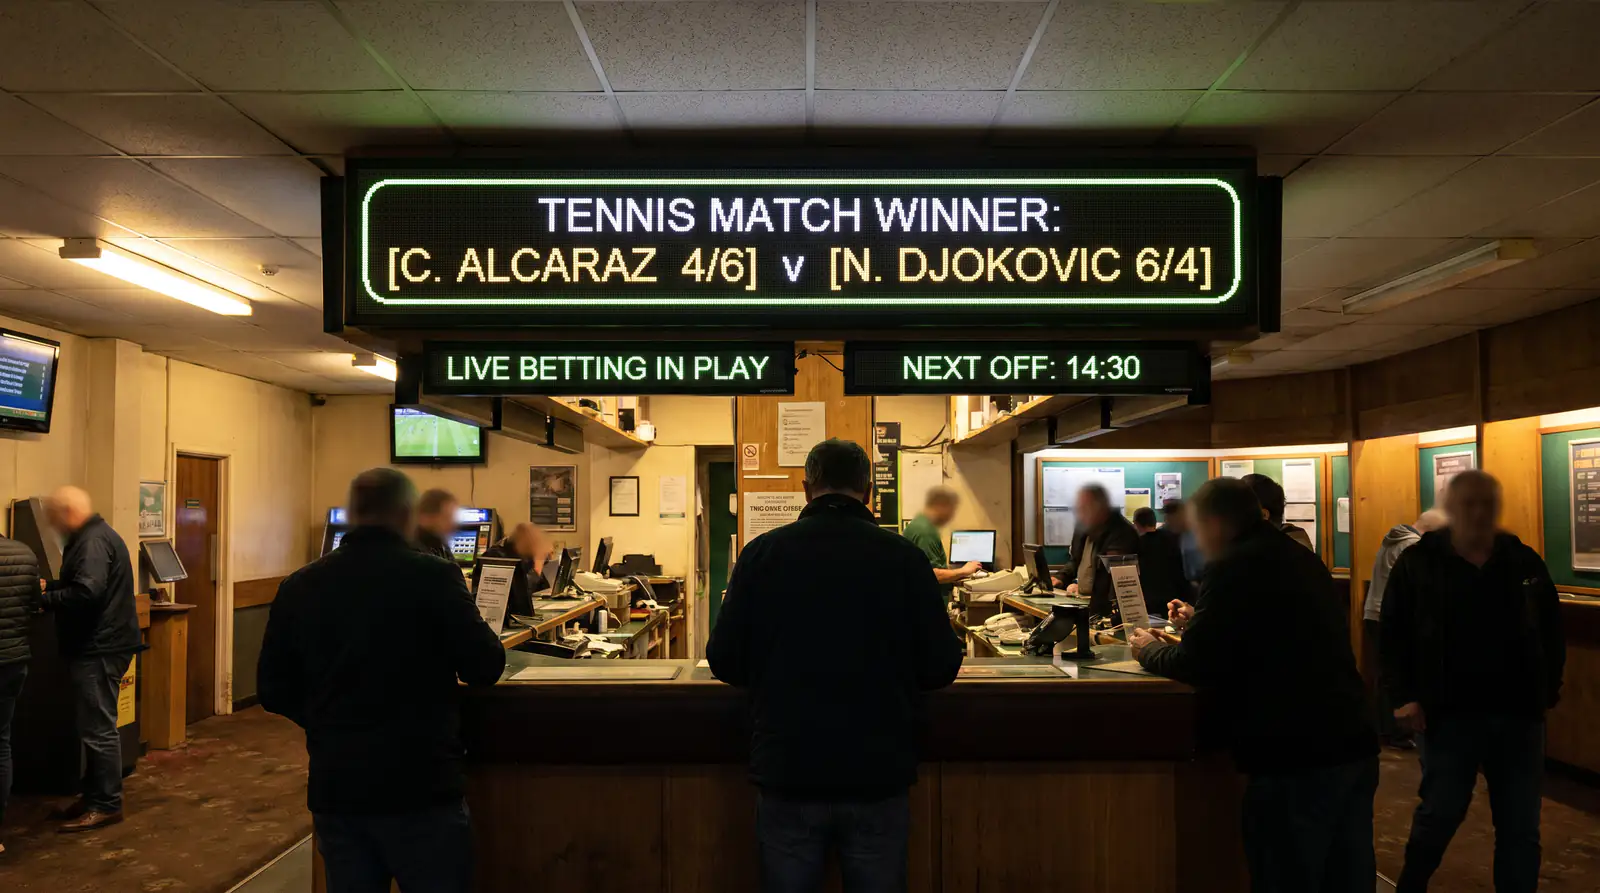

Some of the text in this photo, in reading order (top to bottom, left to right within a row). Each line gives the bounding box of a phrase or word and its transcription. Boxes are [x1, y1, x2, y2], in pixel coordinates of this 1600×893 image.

[537, 197, 1061, 233] TENNIS MATCH WINNER:
[388, 247, 1212, 291] [C. ALCARAZ 4/6] v [N. DJOKOVIC 6/4]
[447, 355, 770, 381] LIVE BETTING IN PLAY
[903, 355, 1140, 380] NEXT OFF: 14:30
